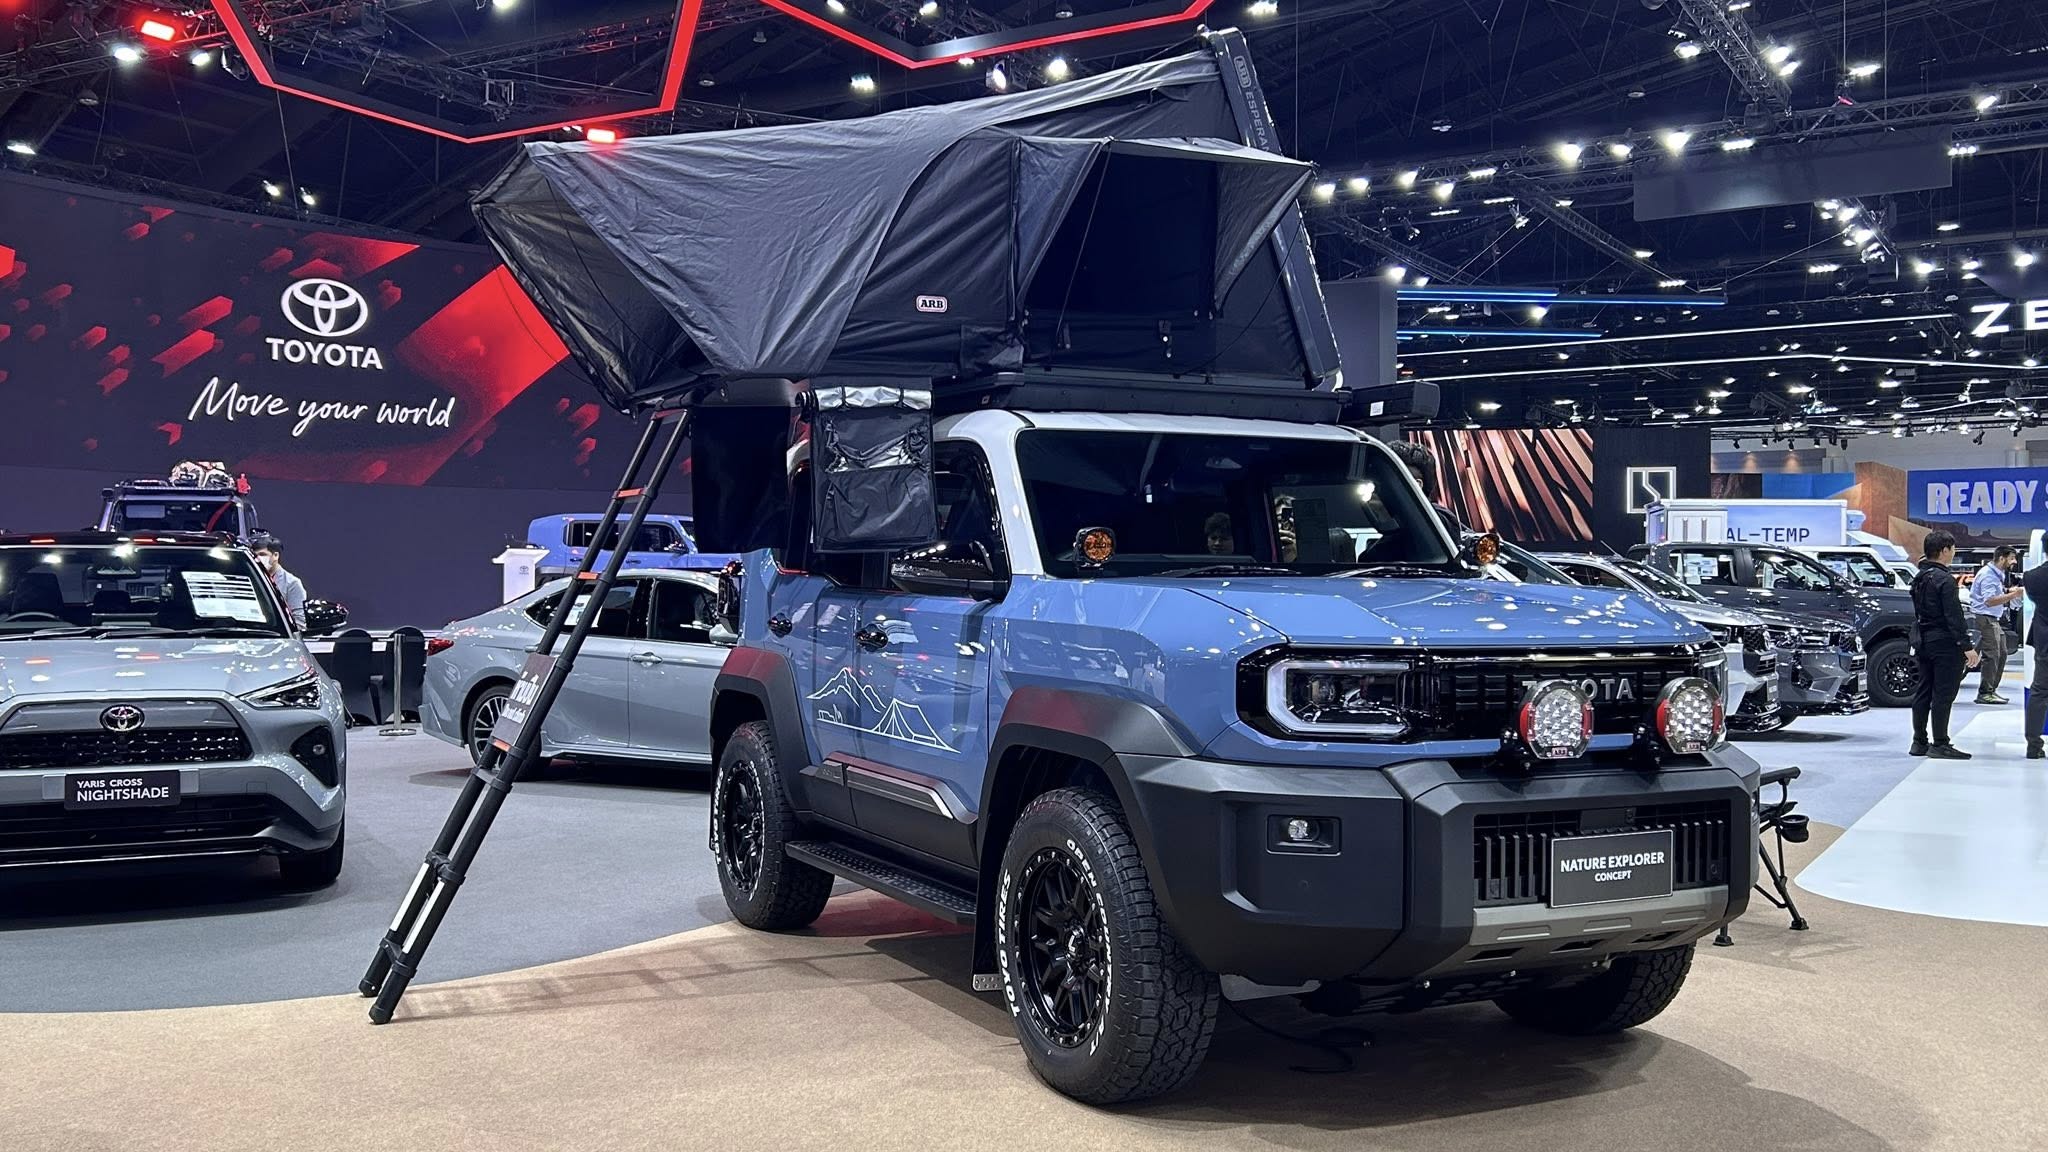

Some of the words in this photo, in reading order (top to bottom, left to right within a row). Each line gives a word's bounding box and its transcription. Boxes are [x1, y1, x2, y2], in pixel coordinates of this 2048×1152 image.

[919, 298, 945, 310] ARB
[265, 337, 383, 370] TOYOTA
[188, 376, 289, 421] Move
[292, 400, 368, 437] your
[376, 397, 455, 428] world
[1927, 480, 2039, 515] READY
[77, 780, 106, 789] YARIS
[109, 778, 143, 787] CROSS
[77, 786, 169, 802] NIGHTSHADE
[1066, 839, 1097, 887] OPEN
[1560, 856, 1607, 872] NATURE
[1608, 851, 1665, 868] EXPLORER
[1594, 870, 1632, 882] CONCEPT
[999, 868, 1011, 944] TIRES
[1000, 949, 1020, 1017] TOYO
